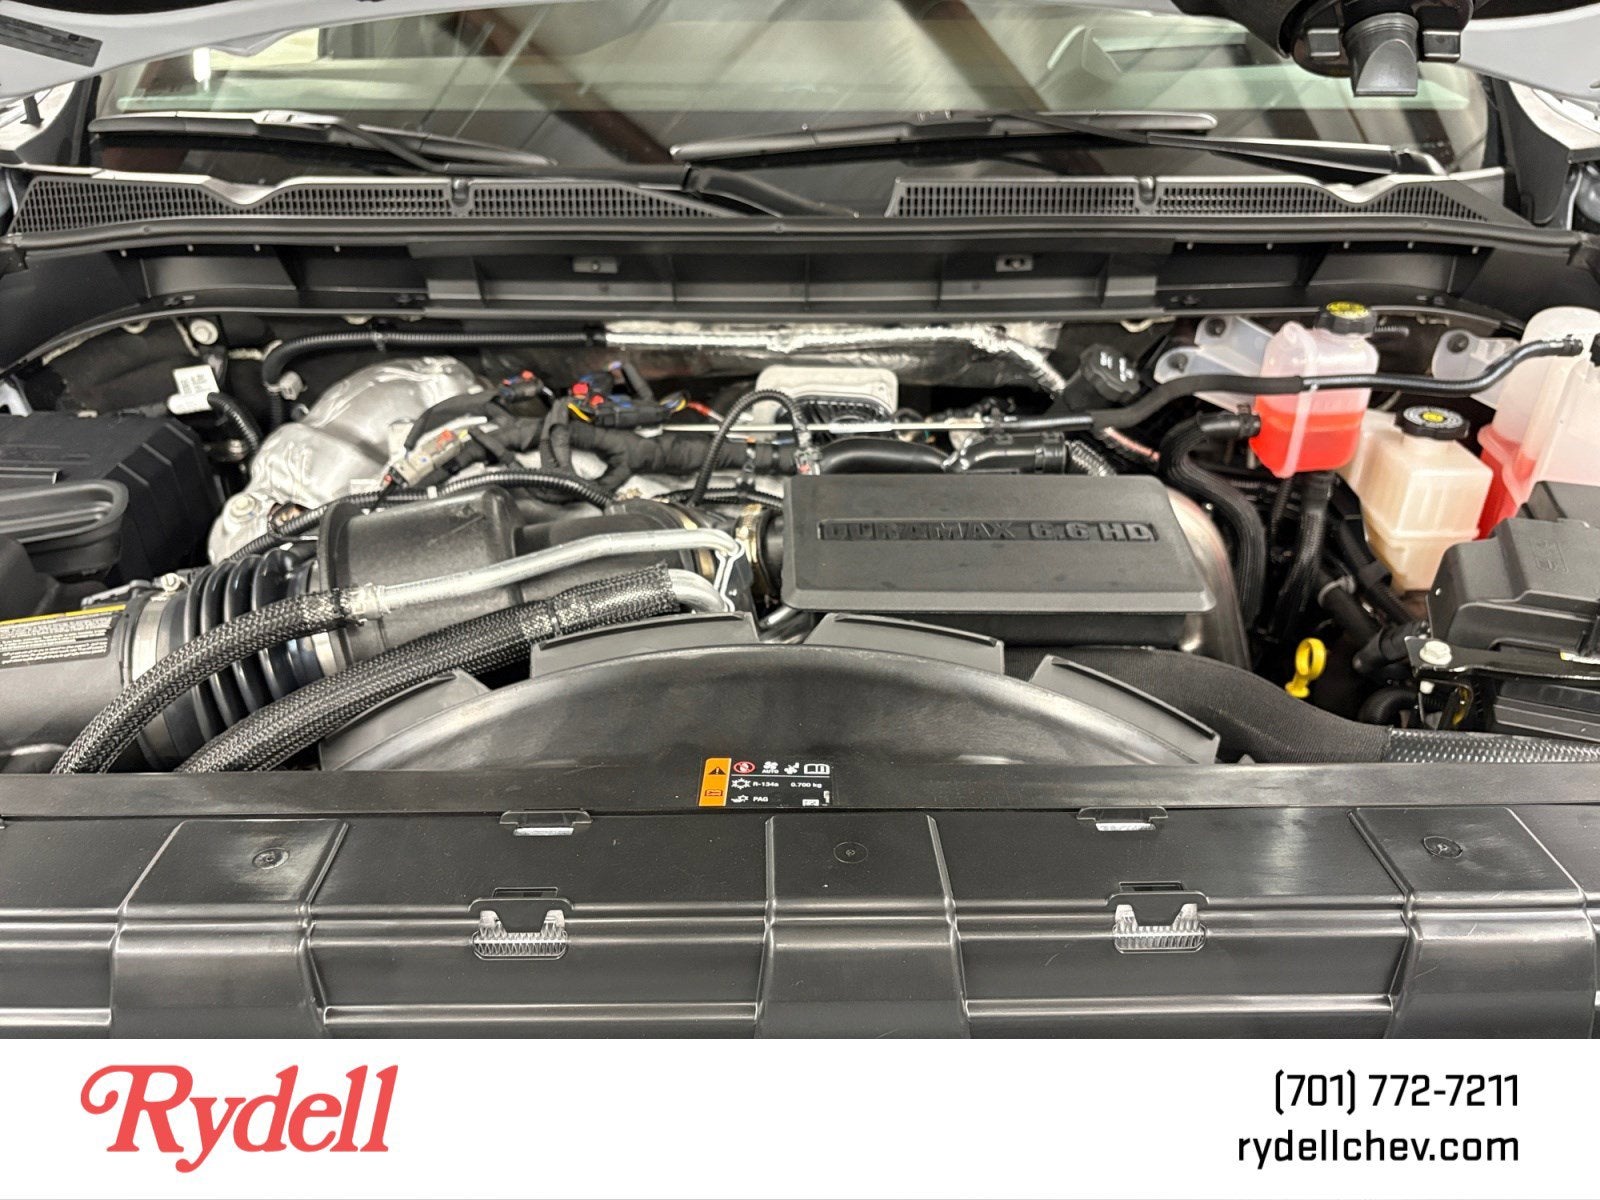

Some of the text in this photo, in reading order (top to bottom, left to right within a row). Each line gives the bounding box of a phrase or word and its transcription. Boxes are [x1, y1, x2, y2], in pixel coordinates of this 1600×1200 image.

[823, 521, 1155, 541] DURAMAX 6.6 HD
[752, 795, 769, 803] PAG
